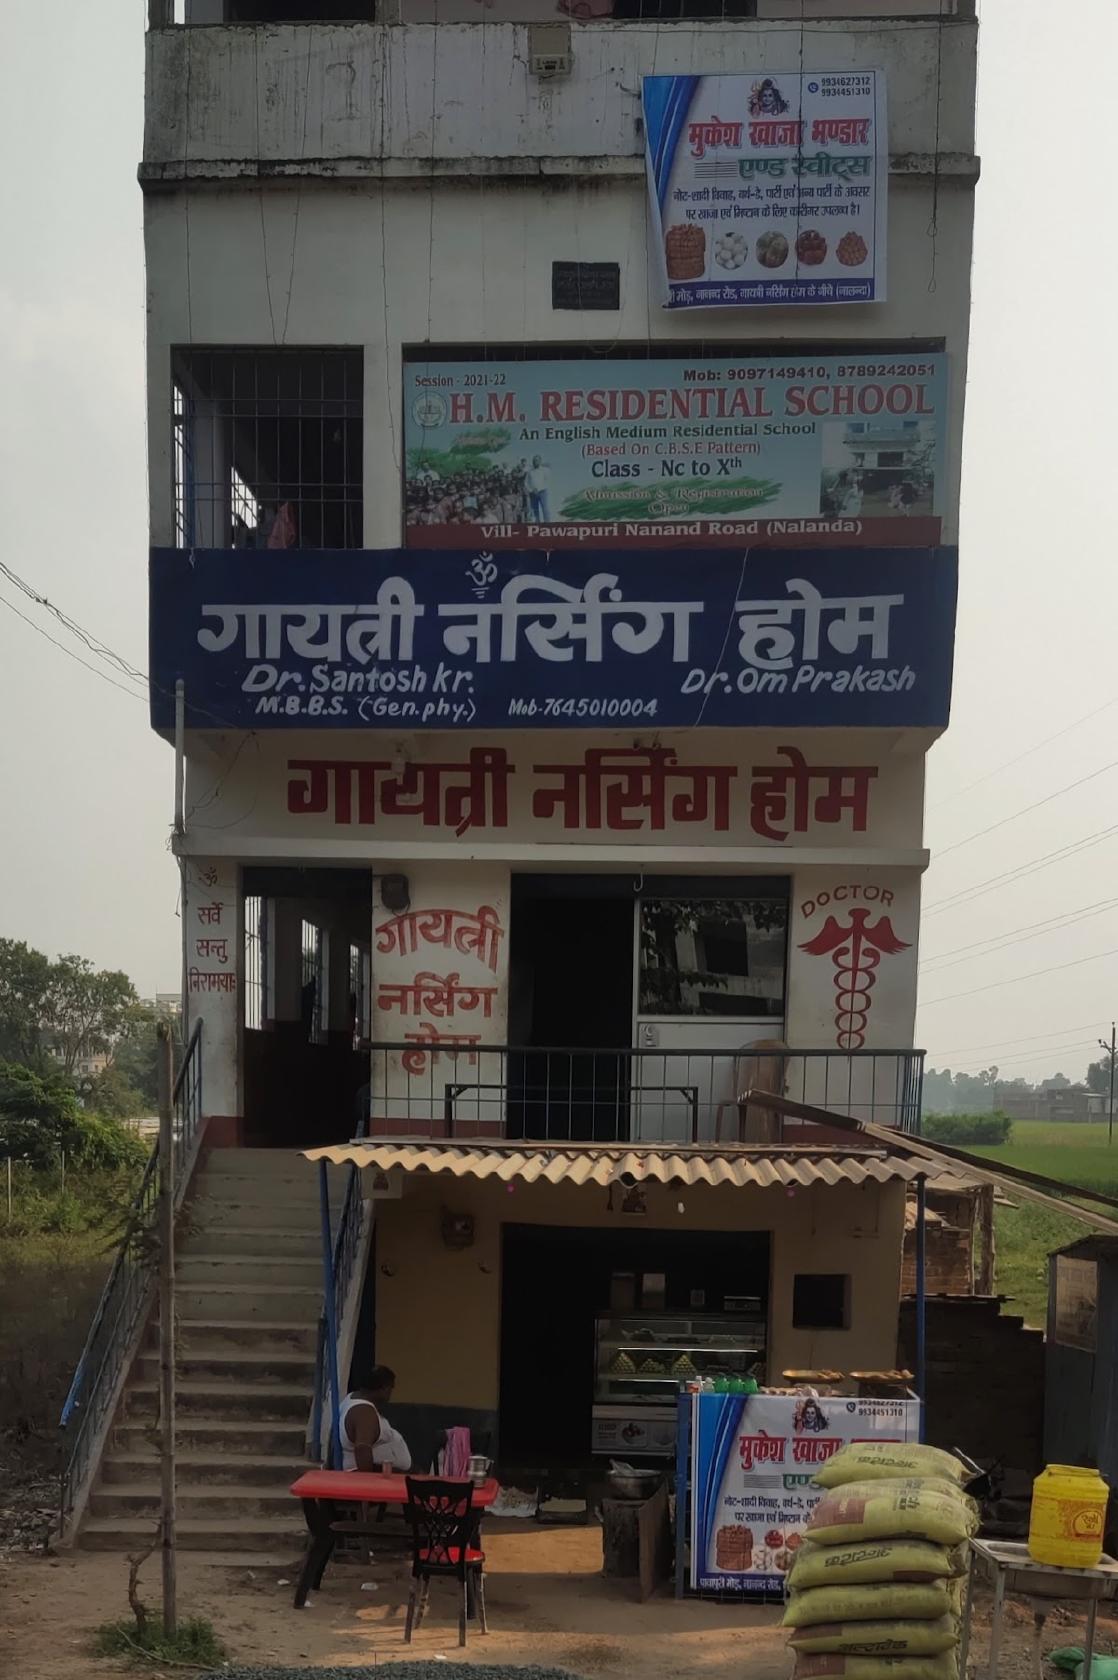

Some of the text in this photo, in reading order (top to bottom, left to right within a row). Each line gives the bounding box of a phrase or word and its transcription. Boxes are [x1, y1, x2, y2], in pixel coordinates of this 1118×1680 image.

[688, 115, 870, 158] मुकेश खाजा भण्डार
[738, 158, 787, 179] एण्ड
[415, 375, 453, 387] Session
[464, 374, 506, 386] 2021-22
[683, 364, 935, 381] Mob: 9097149410, 8789242051
[449, 383, 935, 423] H.M. RESIDENTIAL SCHOOL
[520, 428, 539, 440] An
[545, 426, 600, 443] English
[606, 425, 667, 439] Medium
[673, 424, 758, 437] Residential
[763, 422, 816, 436] School
[582, 441, 761, 459] (Based On C.B.S.E Pattern)
[592, 459, 640, 477] Class
[661, 459, 685, 476] Nc
[692, 459, 711, 476] to
[481, 519, 863, 540] Vill- Pawapuri Nanand Road (Nalanda)
[197, 574, 905, 671] गायत्री नर्सिंग होम
[791, 664, 916, 693] Prakash
[255, 695, 348, 716] M.B.B.S.
[288, 746, 879, 841] गायत्री नर्सिंग होम
[800, 884, 895, 918] DOCTOR
[197, 902, 224, 925] सर्वे
[375, 905, 504, 974] गायत्री
[739, 1429, 786, 1471] मुकेश
